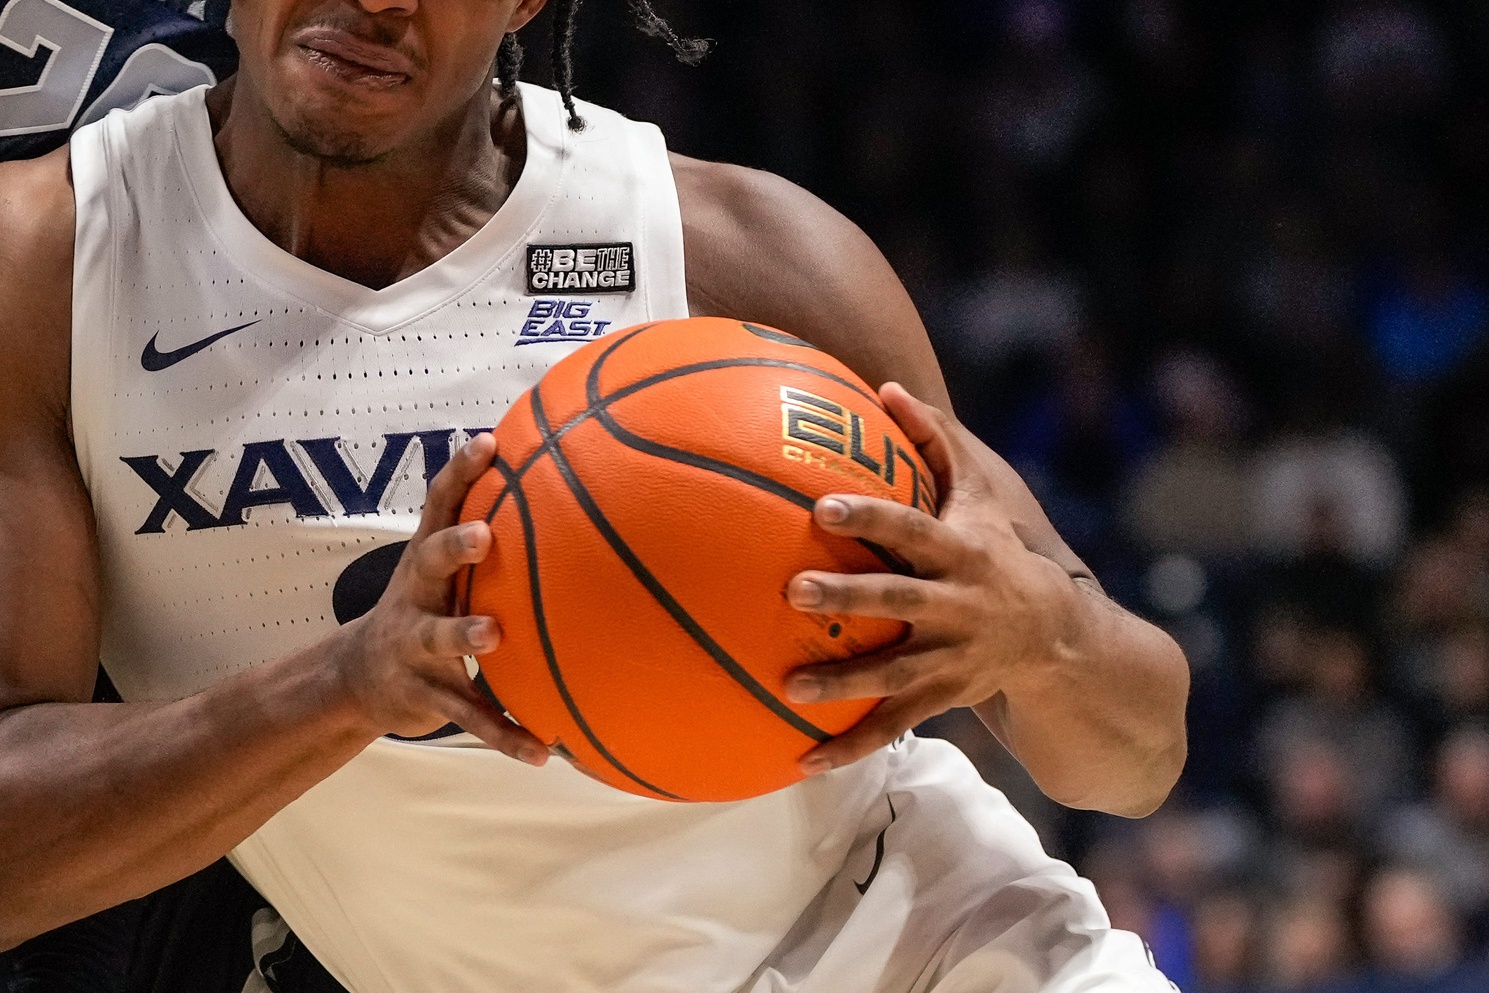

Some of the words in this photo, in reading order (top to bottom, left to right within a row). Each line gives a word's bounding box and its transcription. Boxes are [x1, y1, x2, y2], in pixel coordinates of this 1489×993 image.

[532, 270, 630, 289] CHANGE
[527, 299, 593, 319] BIG
[518, 319, 612, 337] EAST
[119, 427, 497, 535] XAVI
